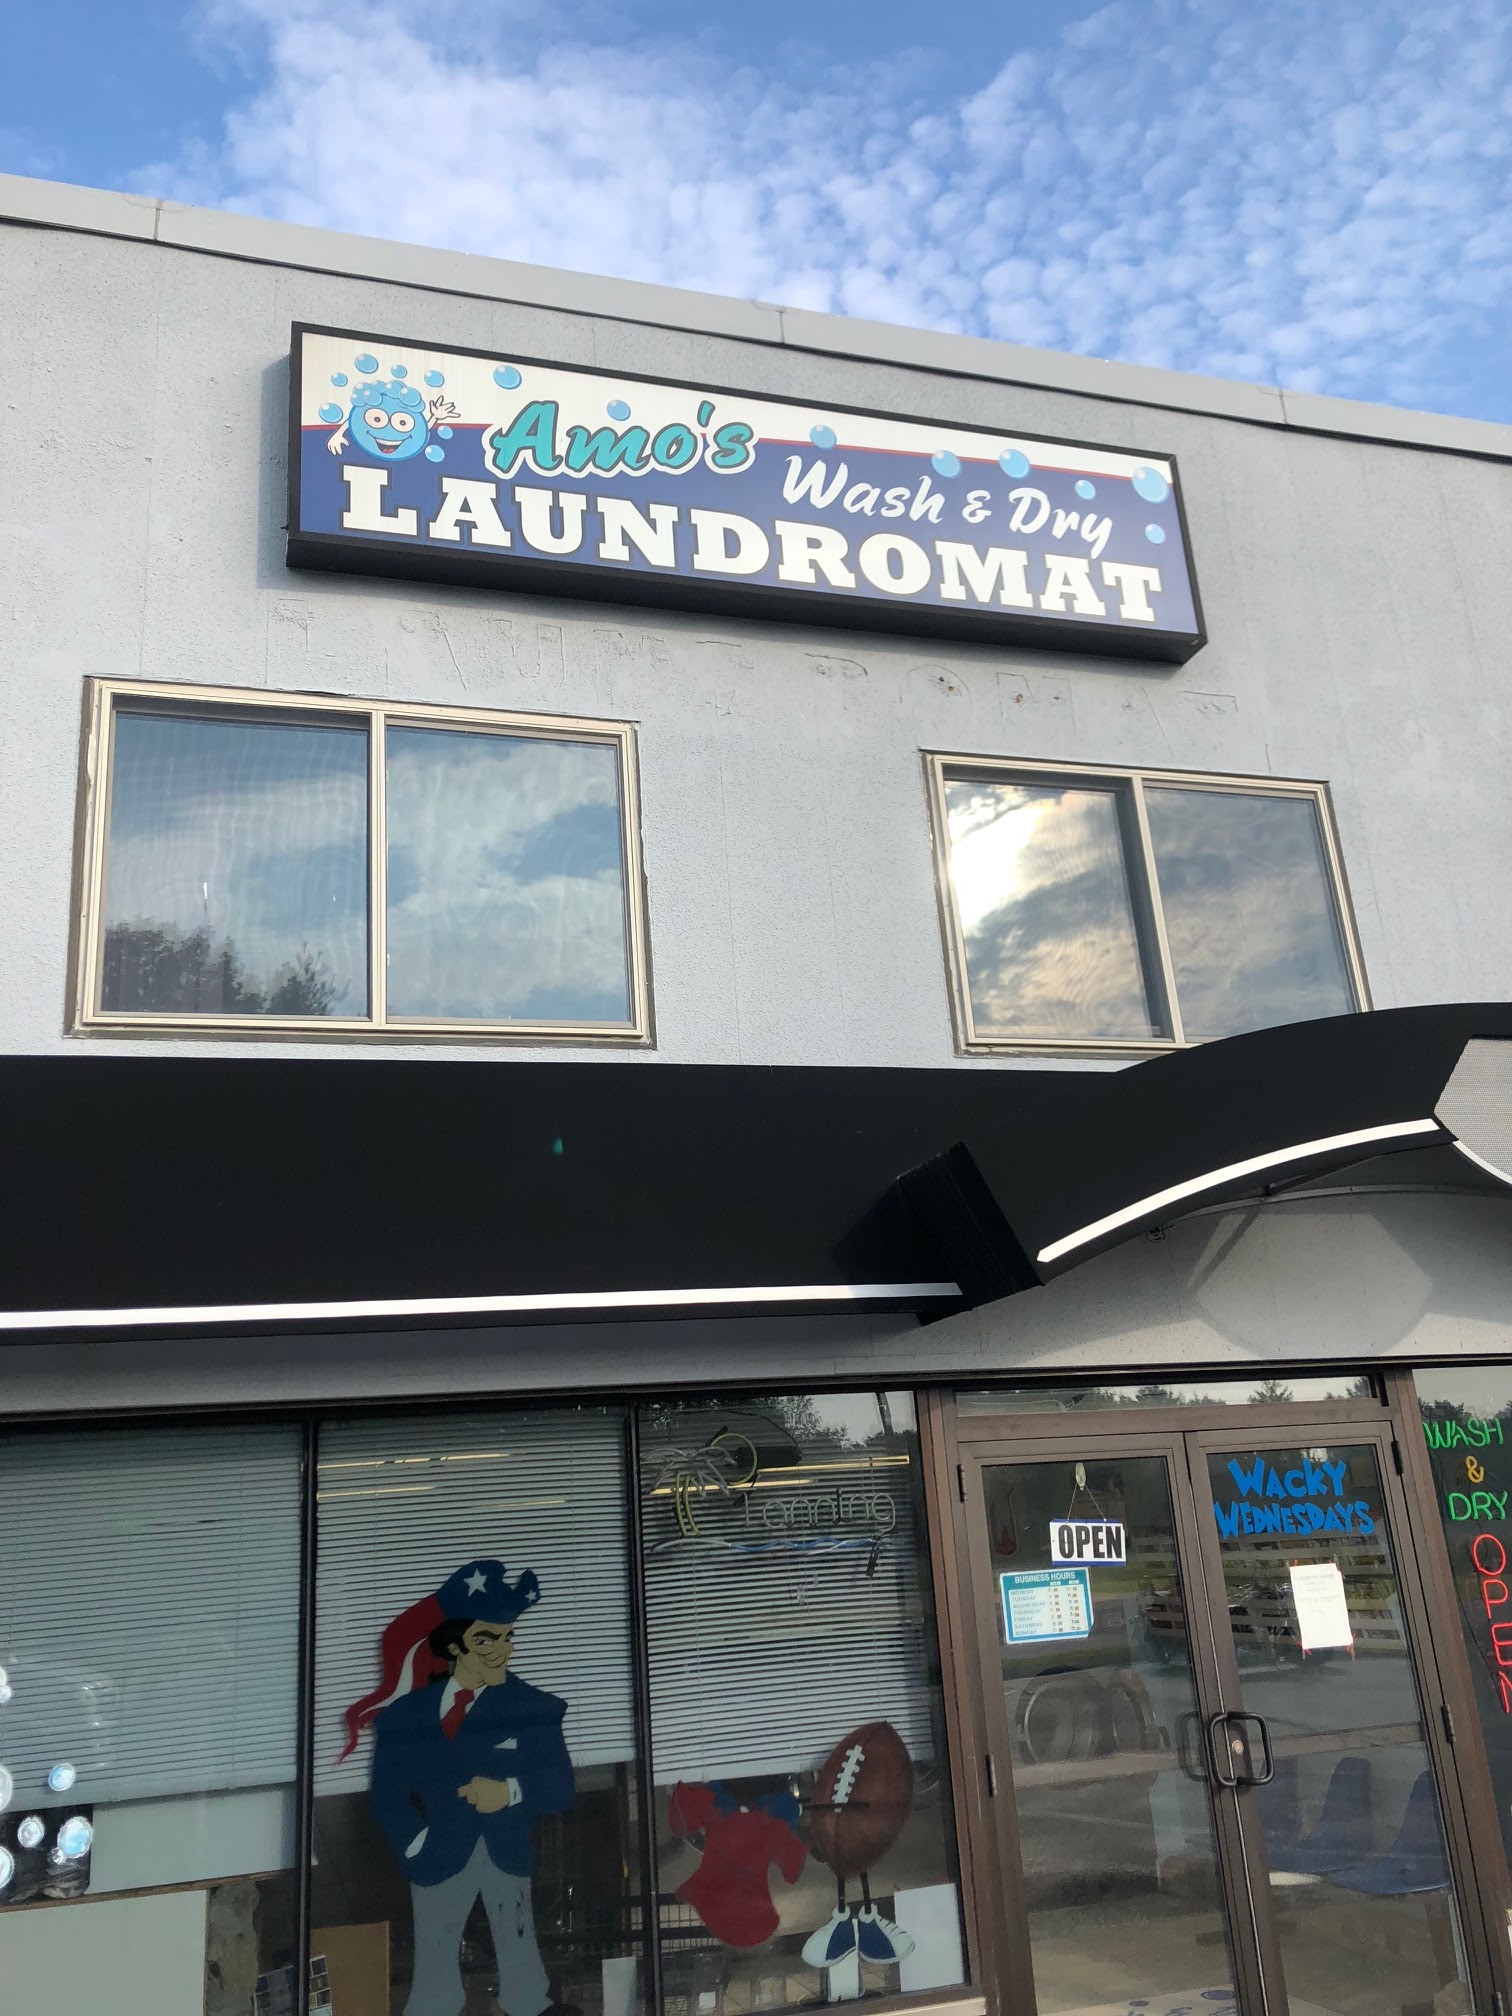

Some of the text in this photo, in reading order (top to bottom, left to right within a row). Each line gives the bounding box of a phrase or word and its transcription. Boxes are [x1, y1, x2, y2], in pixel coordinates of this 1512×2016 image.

[488, 399, 755, 473] Amo's
[782, 454, 1113, 559] Wash & Dry
[342, 464, 1162, 623] LAUNDROMAT
[1421, 1416, 1504, 1449] WASH
[1227, 1457, 1347, 1499] WACKY
[1465, 1455, 1485, 1484] &
[1213, 1500, 1375, 1540] WEDNESDAYS
[1448, 1490, 1508, 1522] DRY
[1058, 1524, 1123, 1559] OPEN
[1014, 1571, 1076, 1584] BUSINESS HOURS
